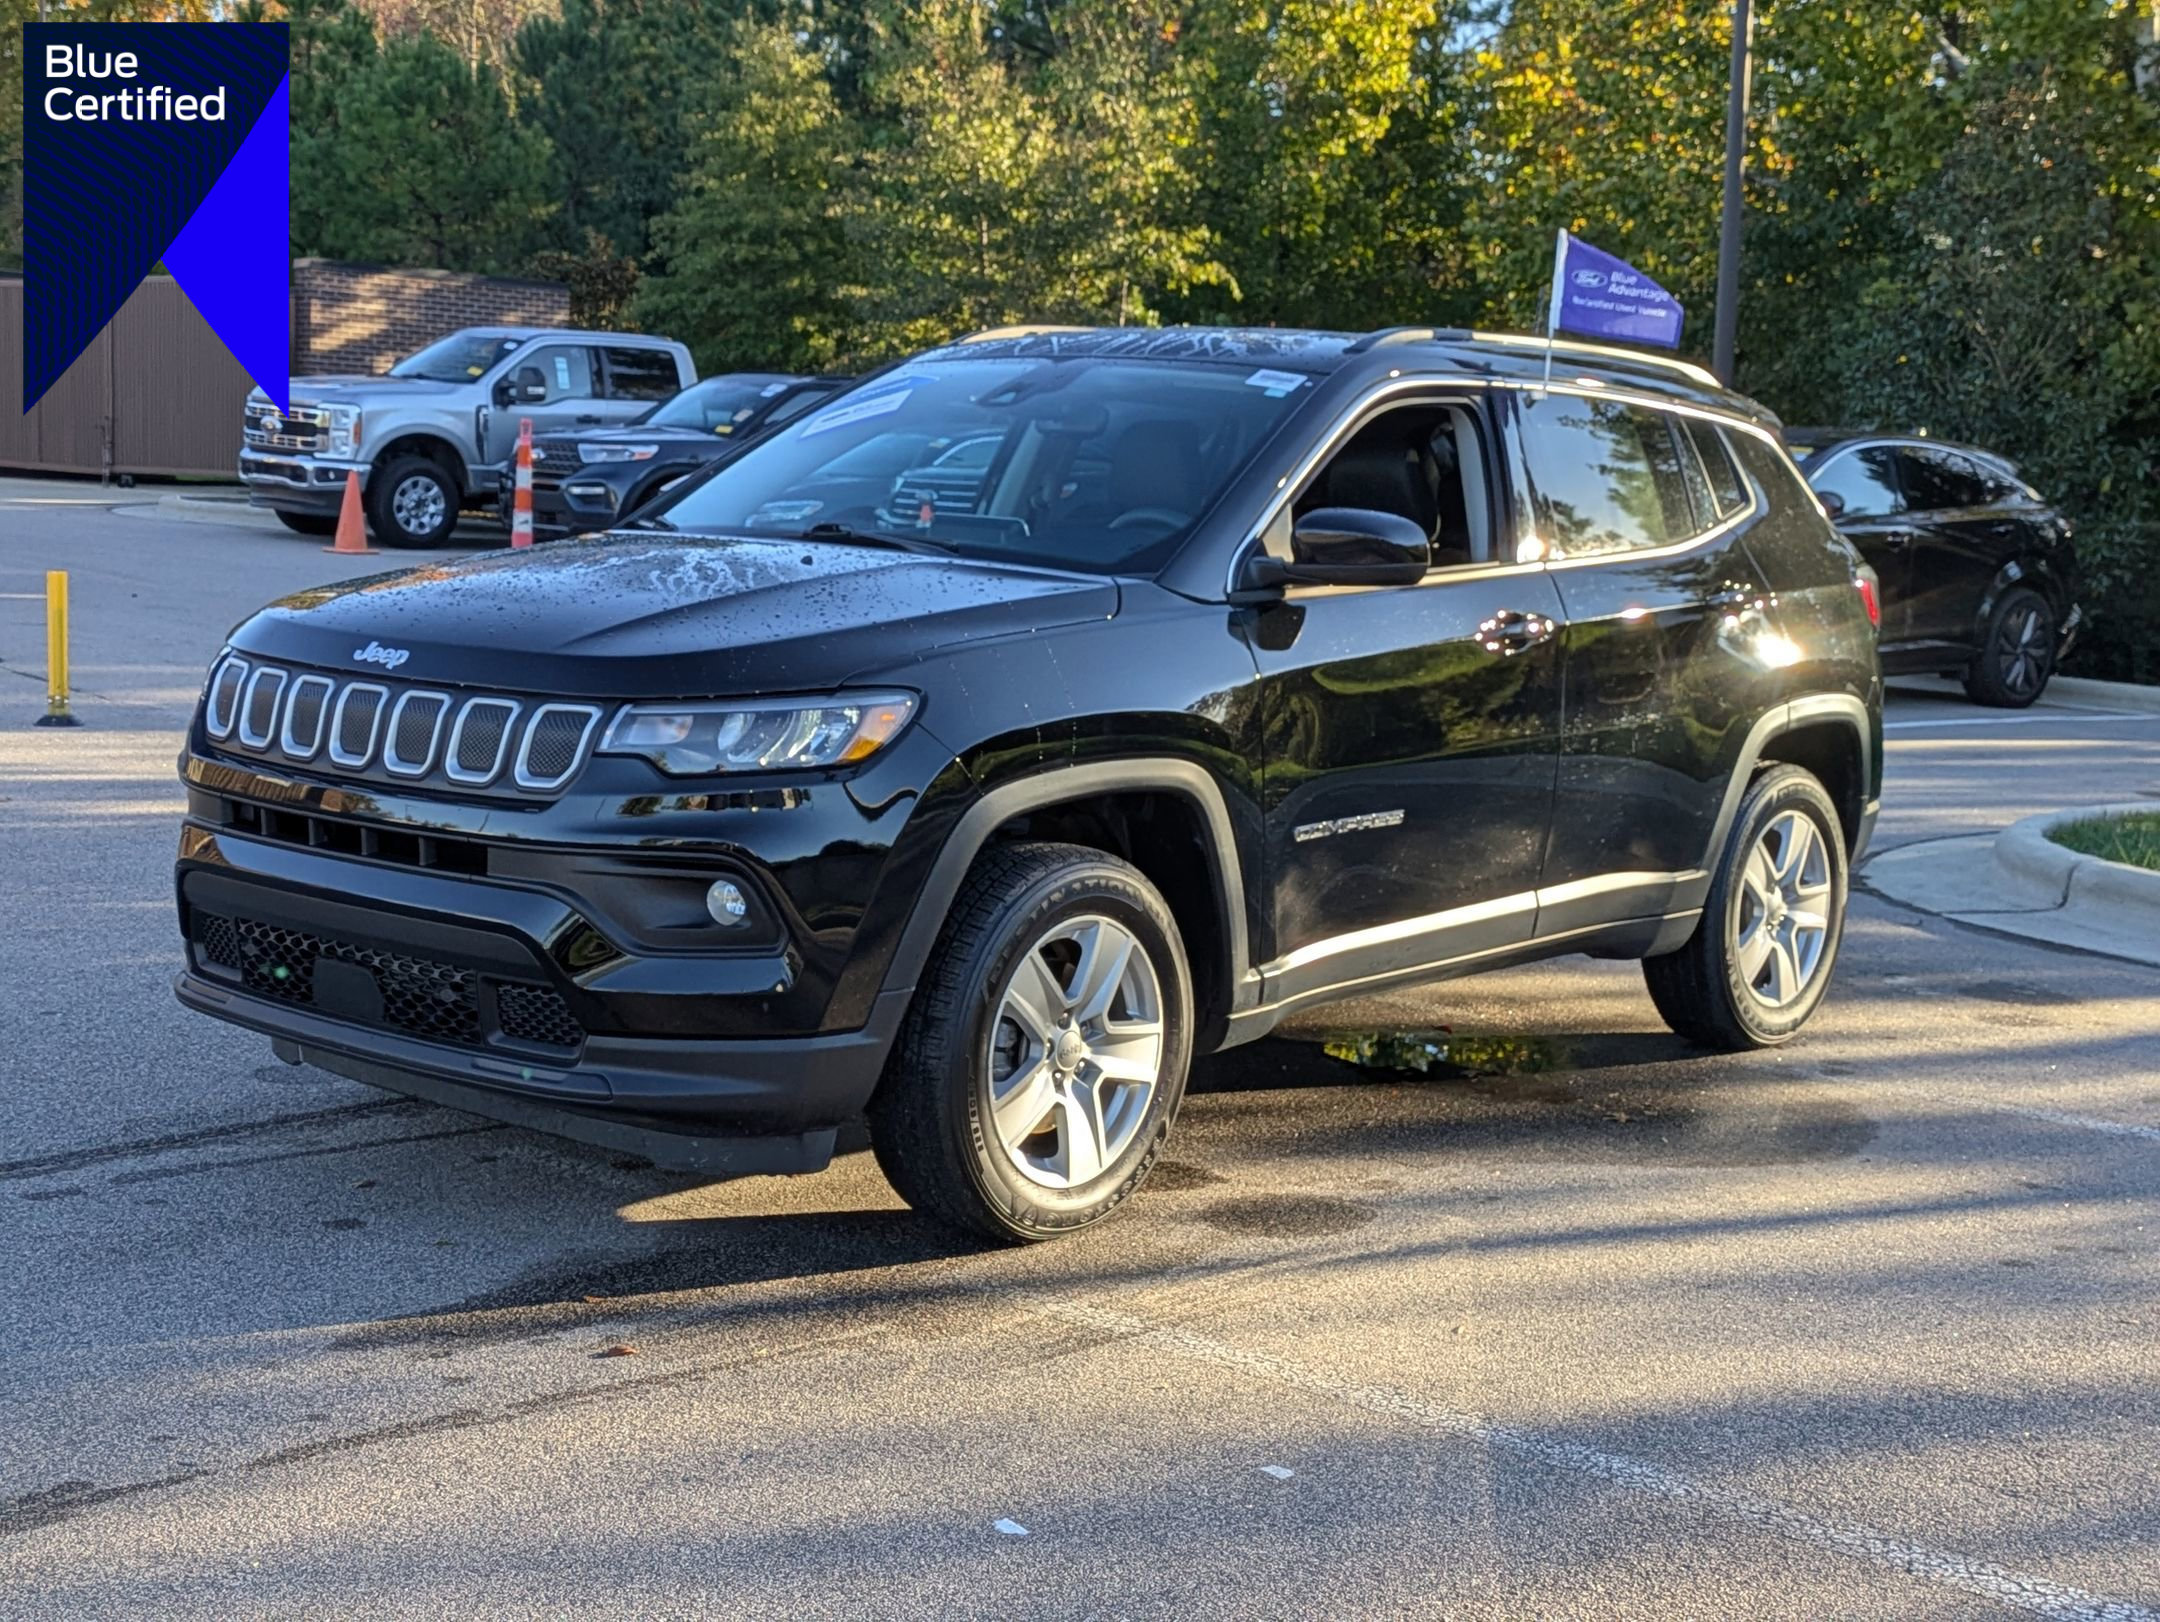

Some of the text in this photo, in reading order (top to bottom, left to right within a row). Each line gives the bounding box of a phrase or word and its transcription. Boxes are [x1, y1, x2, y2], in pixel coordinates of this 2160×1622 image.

[1611, 271, 1637, 285] Blue
[1608, 284, 1669, 302] Advantage
[353, 641, 410, 670] Jeep
